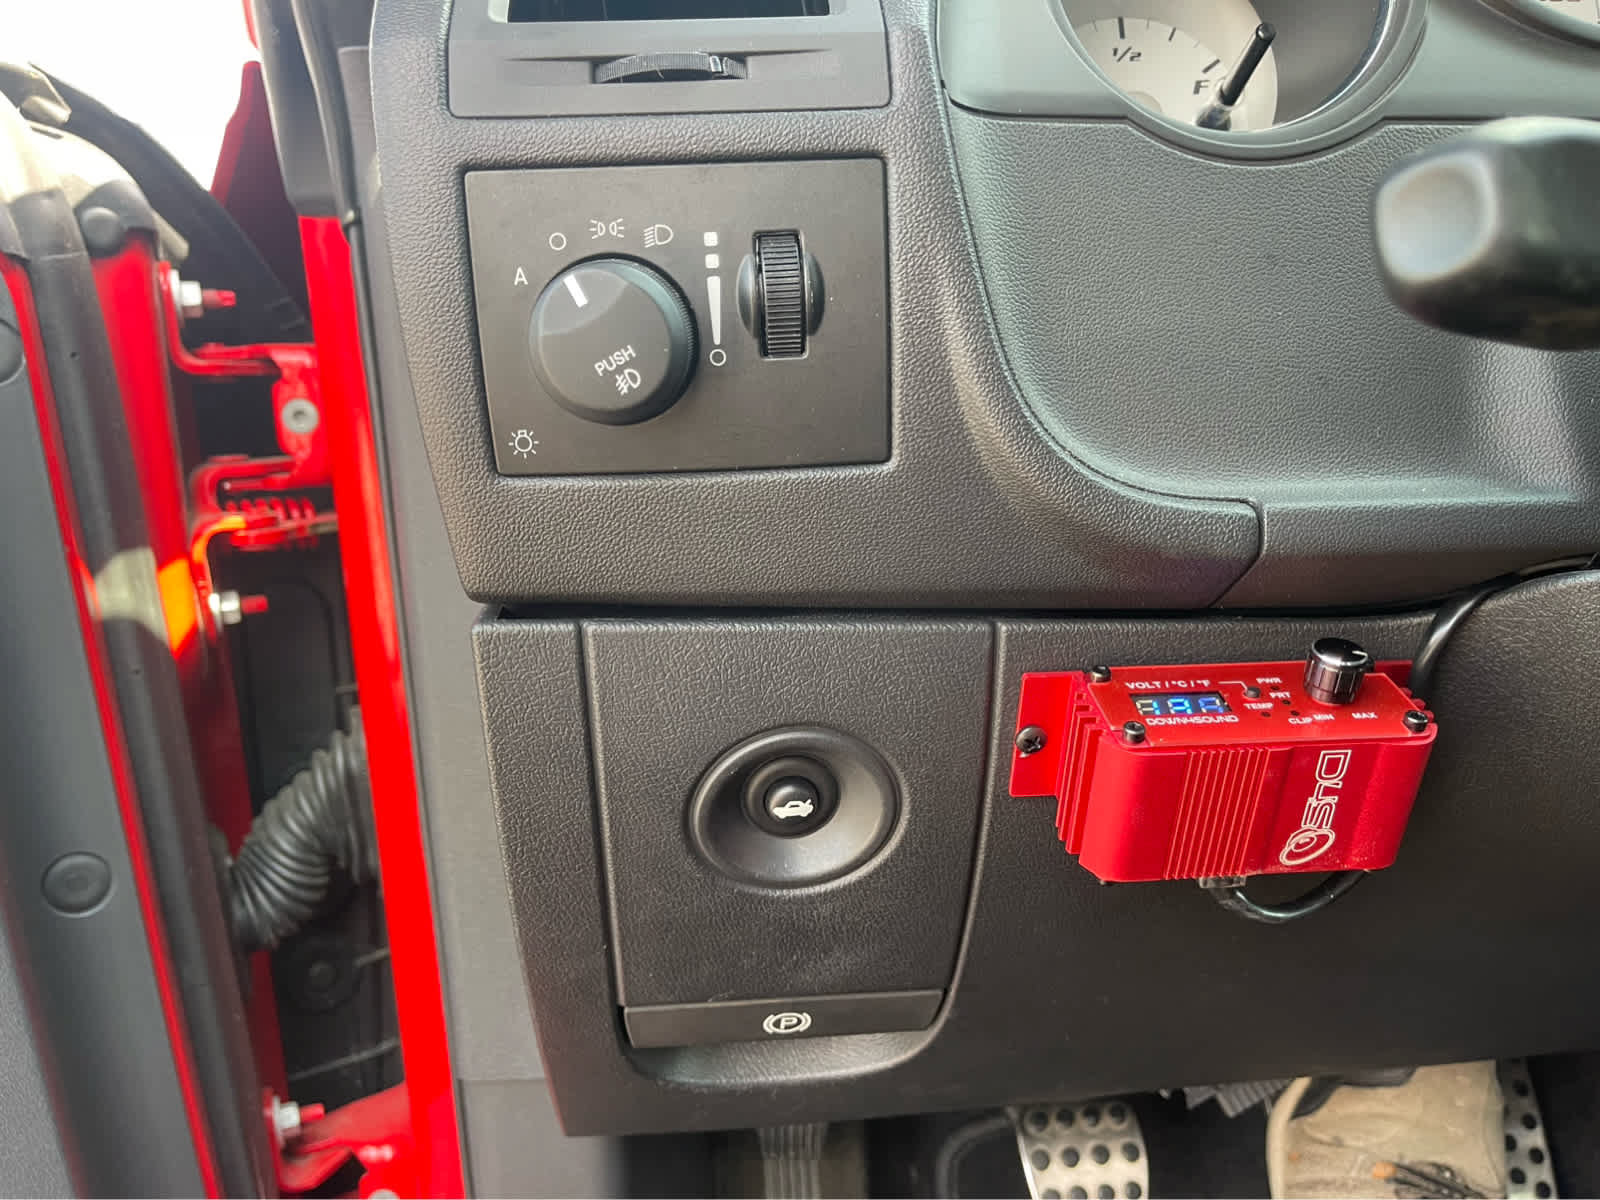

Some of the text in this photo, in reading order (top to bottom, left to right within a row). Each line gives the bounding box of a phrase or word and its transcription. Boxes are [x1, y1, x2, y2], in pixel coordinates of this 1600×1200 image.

[1192, 80, 1210, 95] F
[514, 267, 528, 285] A
[594, 345, 637, 377] PUSH
[1125, 681, 1160, 690] VOLT
[1243, 702, 1274, 710] TEMP
[1288, 716, 1312, 725] CLIP
[1313, 713, 1335, 722] MIN
[1352, 712, 1378, 720] MAX
